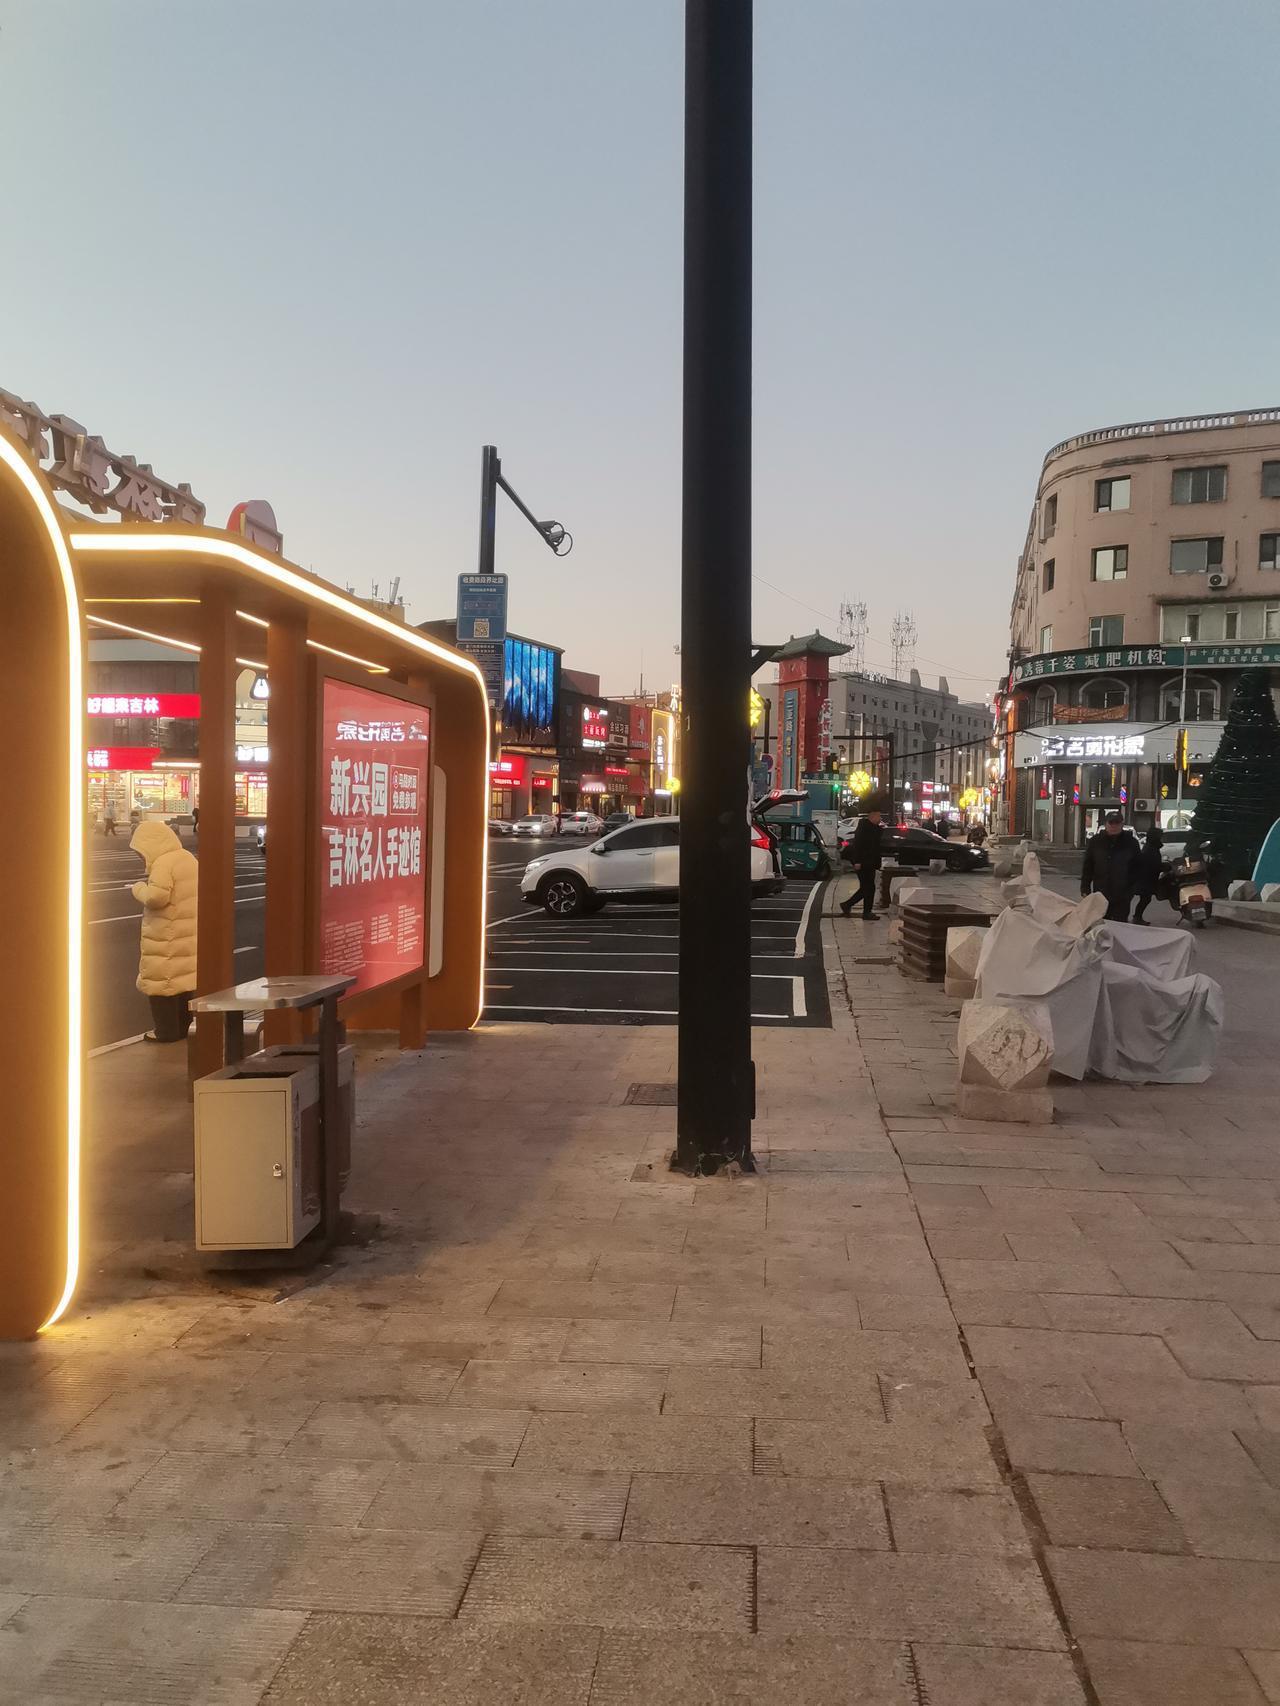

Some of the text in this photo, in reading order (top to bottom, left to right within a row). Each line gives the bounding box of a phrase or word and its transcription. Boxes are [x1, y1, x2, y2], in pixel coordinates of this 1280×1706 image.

[330, 755, 389, 816] 新兴园
[392, 791, 417, 810] 免费参观
[328, 825, 422, 888] 吉林名人手迹馆
